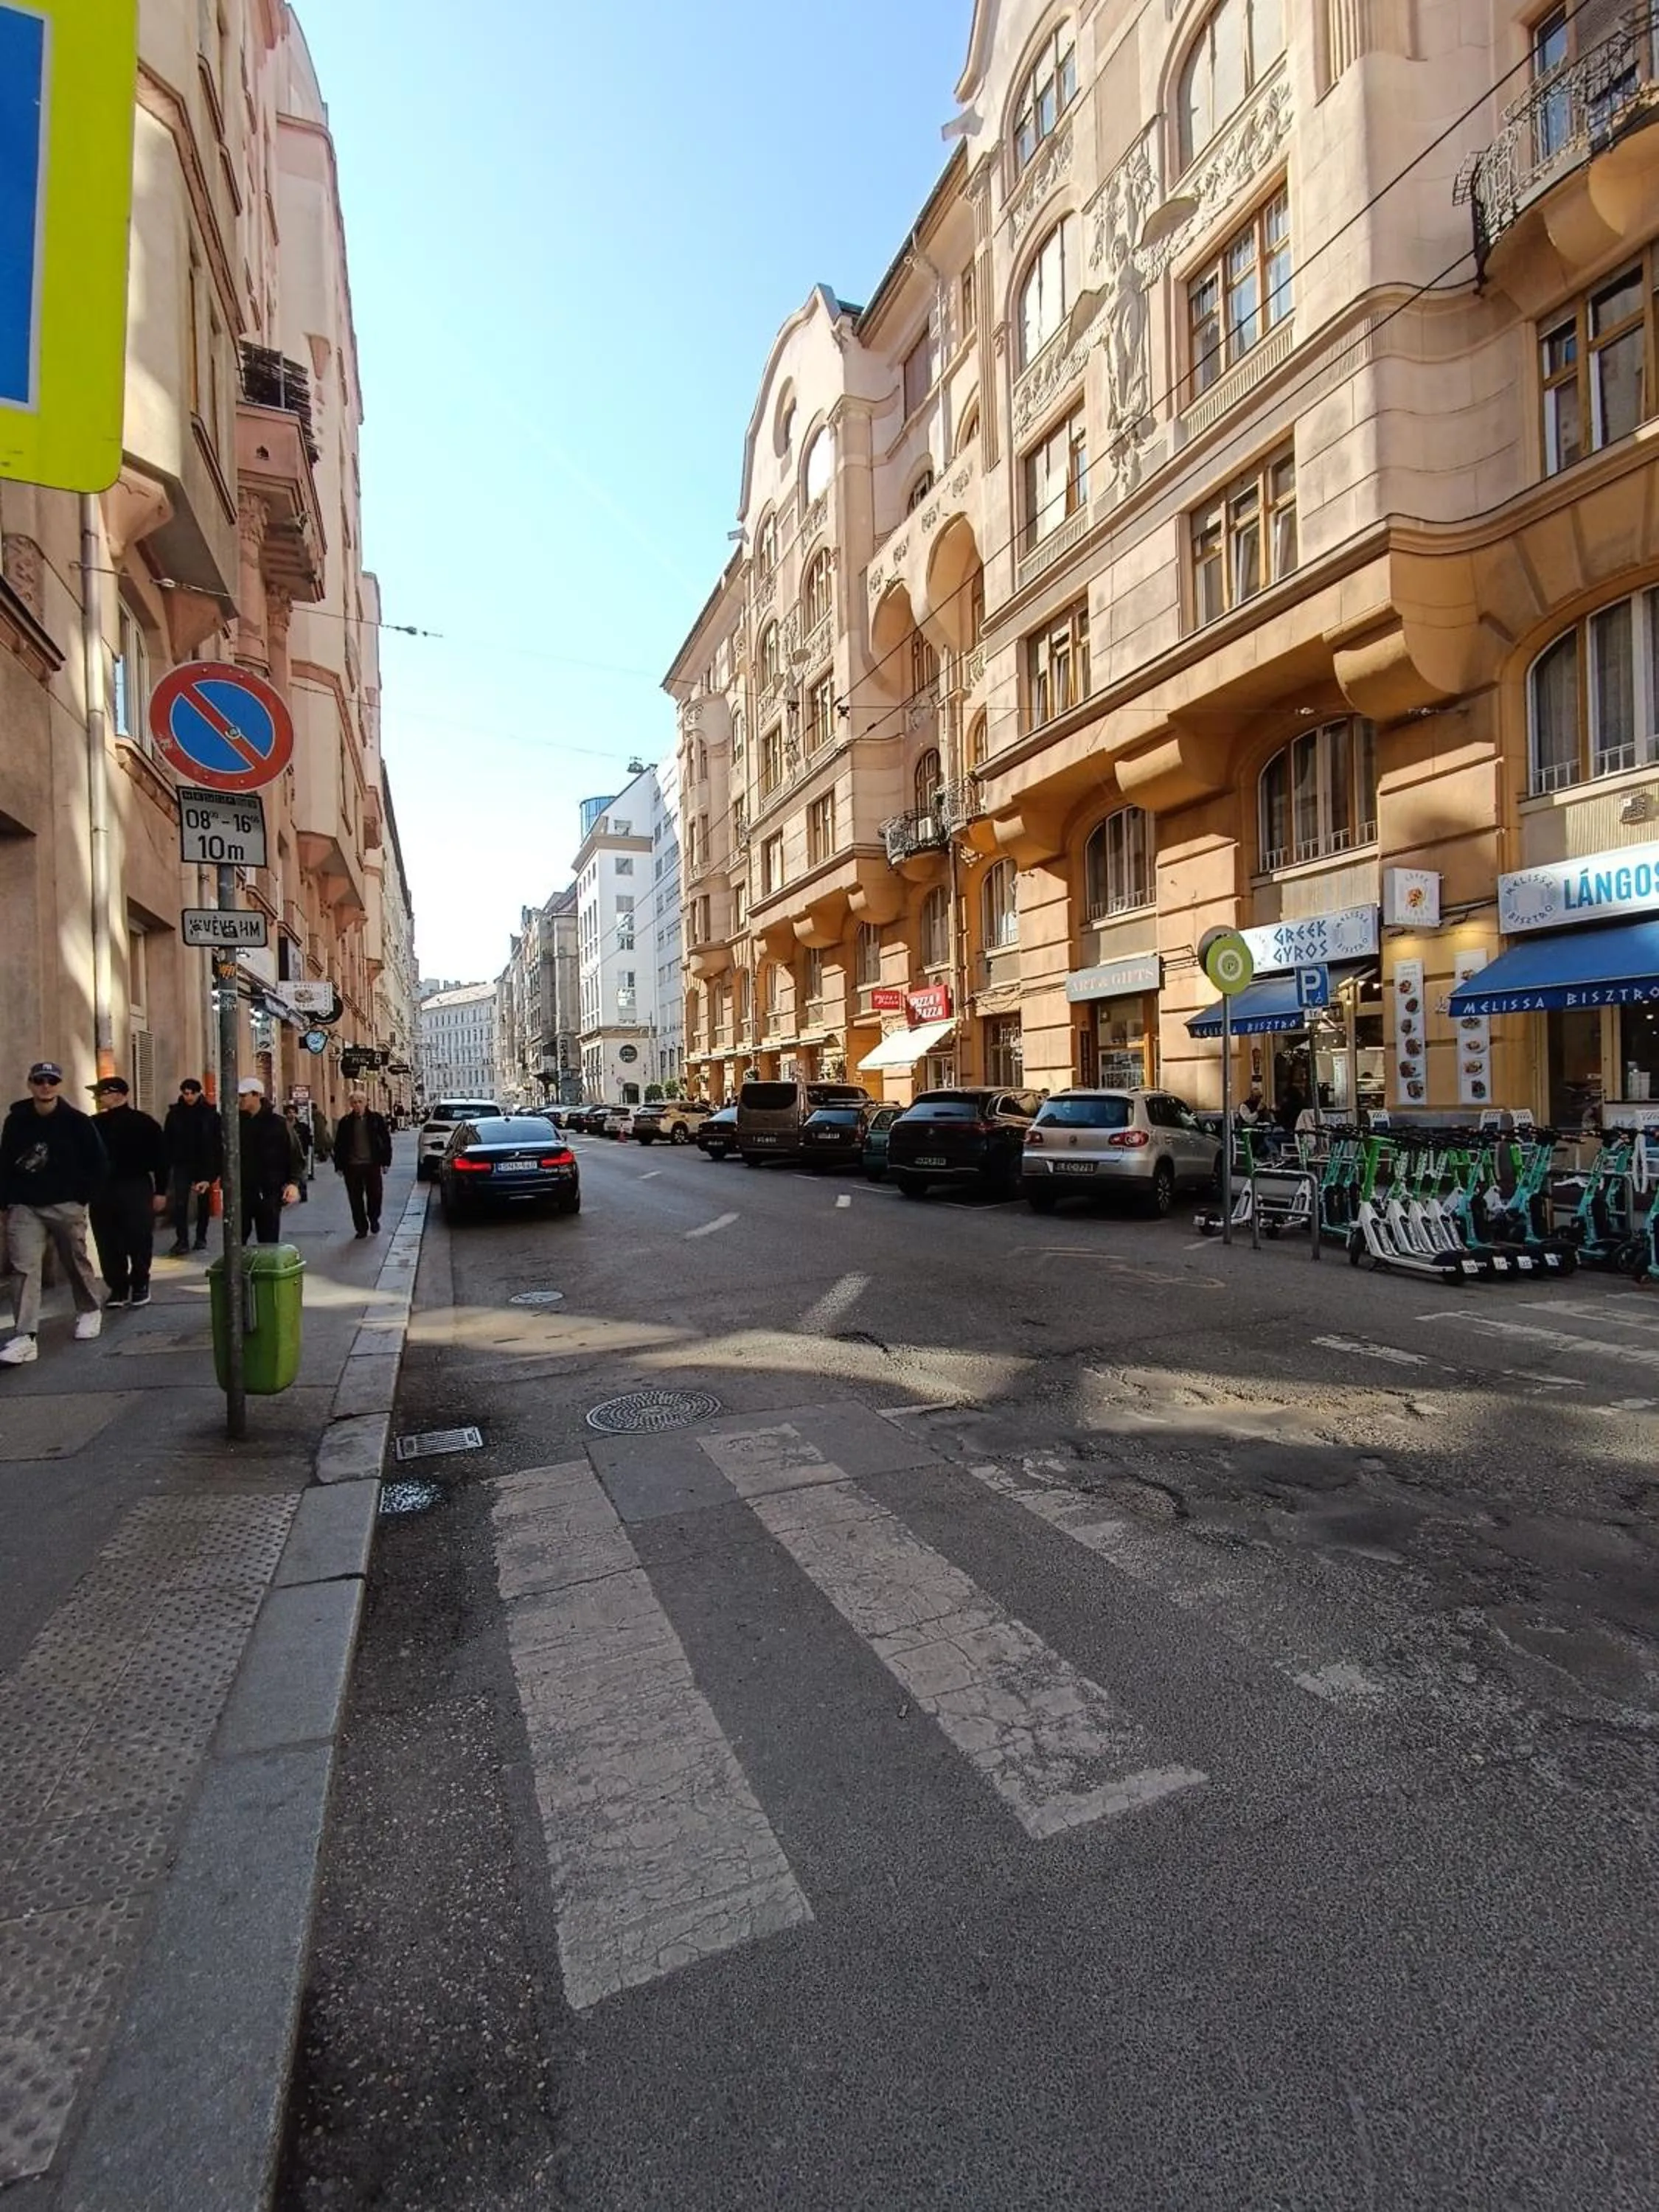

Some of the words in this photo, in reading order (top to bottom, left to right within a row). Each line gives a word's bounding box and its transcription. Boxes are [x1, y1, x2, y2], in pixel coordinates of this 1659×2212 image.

[1273, 919, 1327, 946] GREEK
[1273, 939, 1328, 964] GYROS
[1071, 978, 1096, 992] ART
[1112, 967, 1155, 985] GIFTS
[1300, 969, 1321, 1004] P
[1463, 997, 1545, 1014] MELISSA
[1566, 986, 1659, 1006] BISZTRO
[1194, 1026, 1237, 1036] MELISA
[1247, 1020, 1295, 1032] BISZTRO
